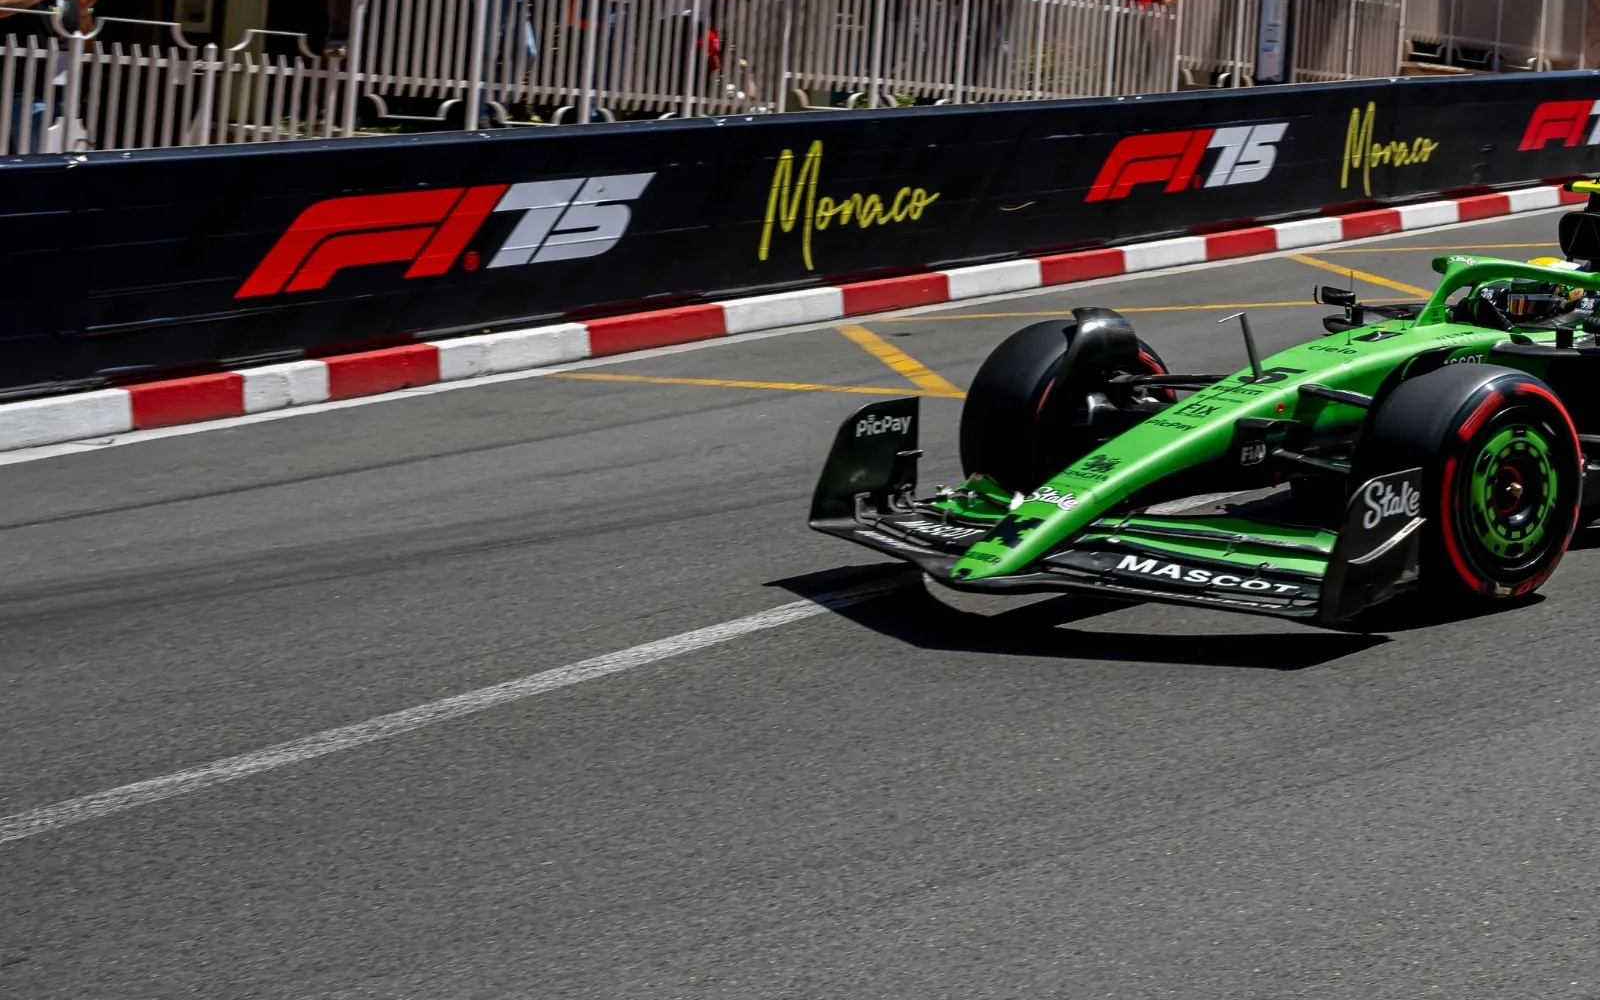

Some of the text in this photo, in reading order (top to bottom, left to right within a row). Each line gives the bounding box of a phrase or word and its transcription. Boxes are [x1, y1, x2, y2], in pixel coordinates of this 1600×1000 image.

[1341, 101, 1439, 197] Monaco
[1518, 100, 1596, 151] F1
[1085, 122, 1290, 202] F1 75
[758, 139, 939, 271] Monaco
[234, 172, 656, 298] F1 75
[1308, 345, 1358, 355] cielo
[856, 414, 912, 438] PicPay
[1026, 486, 1079, 512] Stake
[1363, 479, 1420, 529] Stake
[1116, 554, 1300, 594] MASCOT
